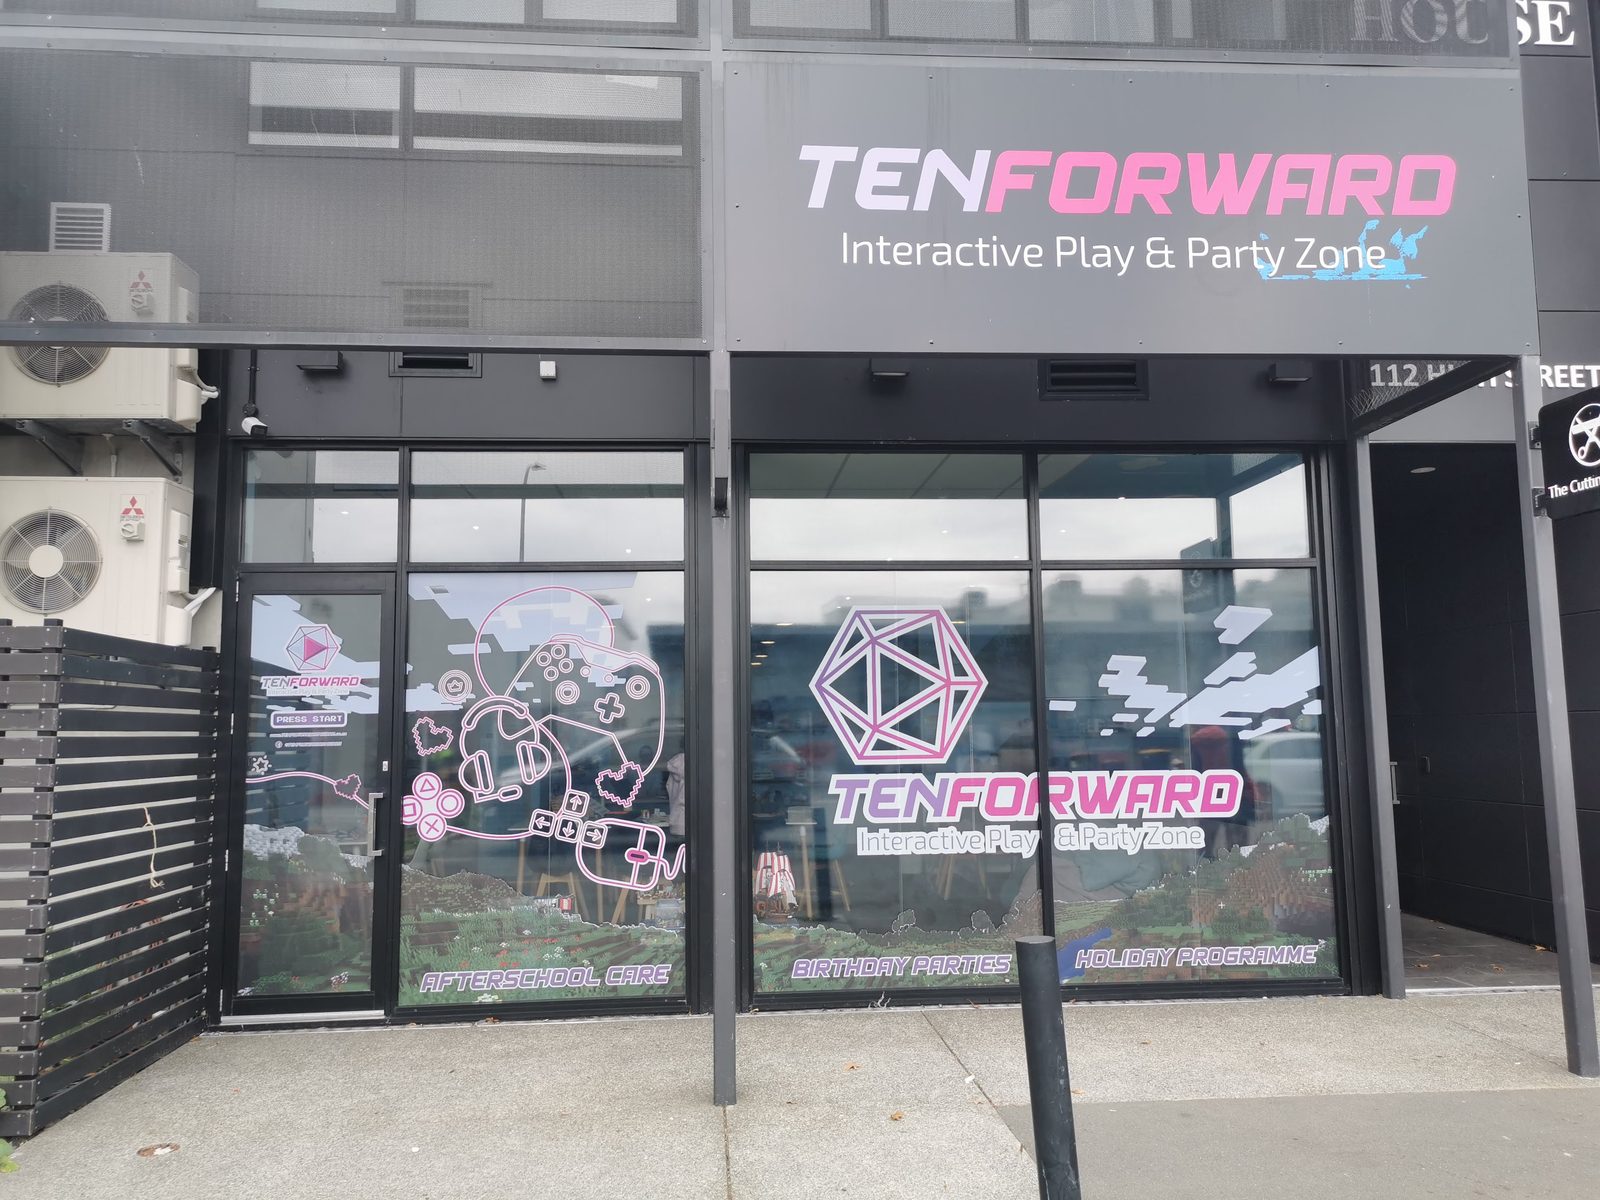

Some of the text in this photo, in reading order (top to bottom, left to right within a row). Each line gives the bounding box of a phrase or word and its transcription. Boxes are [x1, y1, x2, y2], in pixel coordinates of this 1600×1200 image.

[799, 145, 1458, 216] TENFORWARD
[842, 232, 1386, 277] Interactive Play & Party Zone
[1370, 363, 1420, 387] 112
[1547, 484, 1569, 499] The
[261, 676, 360, 688] TENFORWARD
[831, 771, 1241, 822] TENFORWARD
[859, 824, 1203, 856] Interactive Play & Party Zone
[792, 955, 1012, 978] BIRTHDAY PARTIES
[1075, 945, 1318, 968] HOLIDAY PROGRAMME
[420, 964, 672, 992] AFTERSCHOOL CARE
